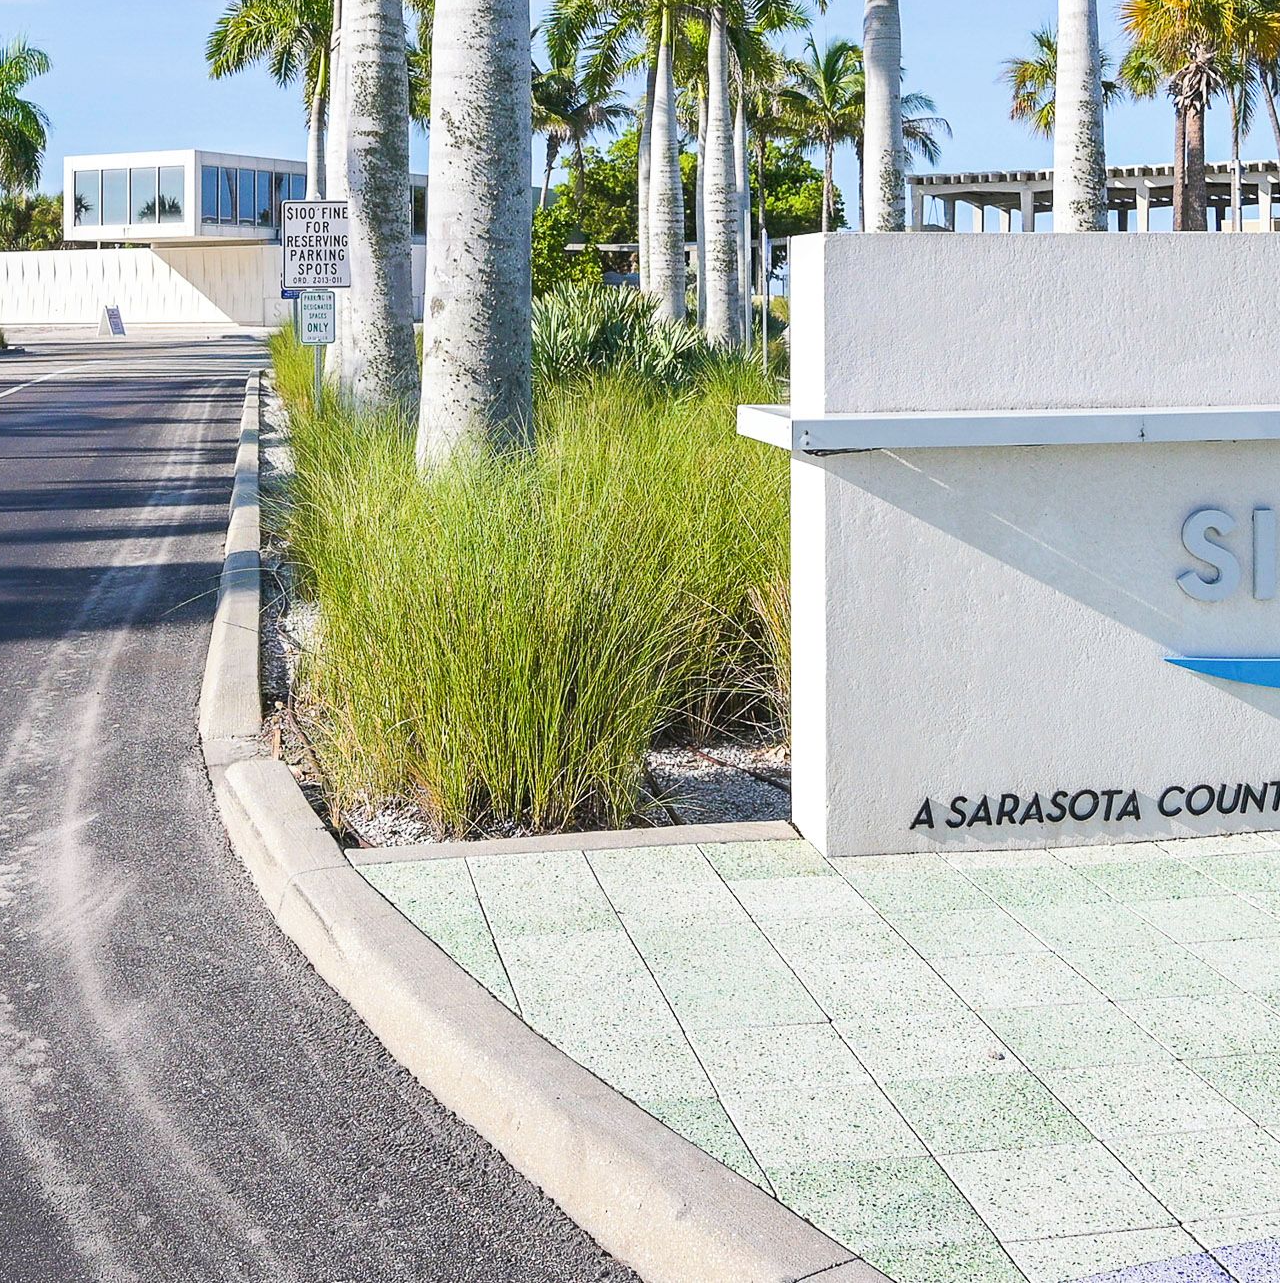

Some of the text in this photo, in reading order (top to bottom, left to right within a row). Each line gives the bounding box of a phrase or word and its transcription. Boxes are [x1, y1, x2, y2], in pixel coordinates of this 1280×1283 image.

[286, 206, 349, 221] $100 FINE
[305, 221, 330, 233] FOR
[286, 234, 348, 248] RESERVING
[290, 248, 345, 262] PARKING
[297, 263, 338, 276] SPOTS
[307, 322, 329, 333] ONLY
[909, 796, 936, 831] A
[945, 788, 1142, 829] SARASOTA
